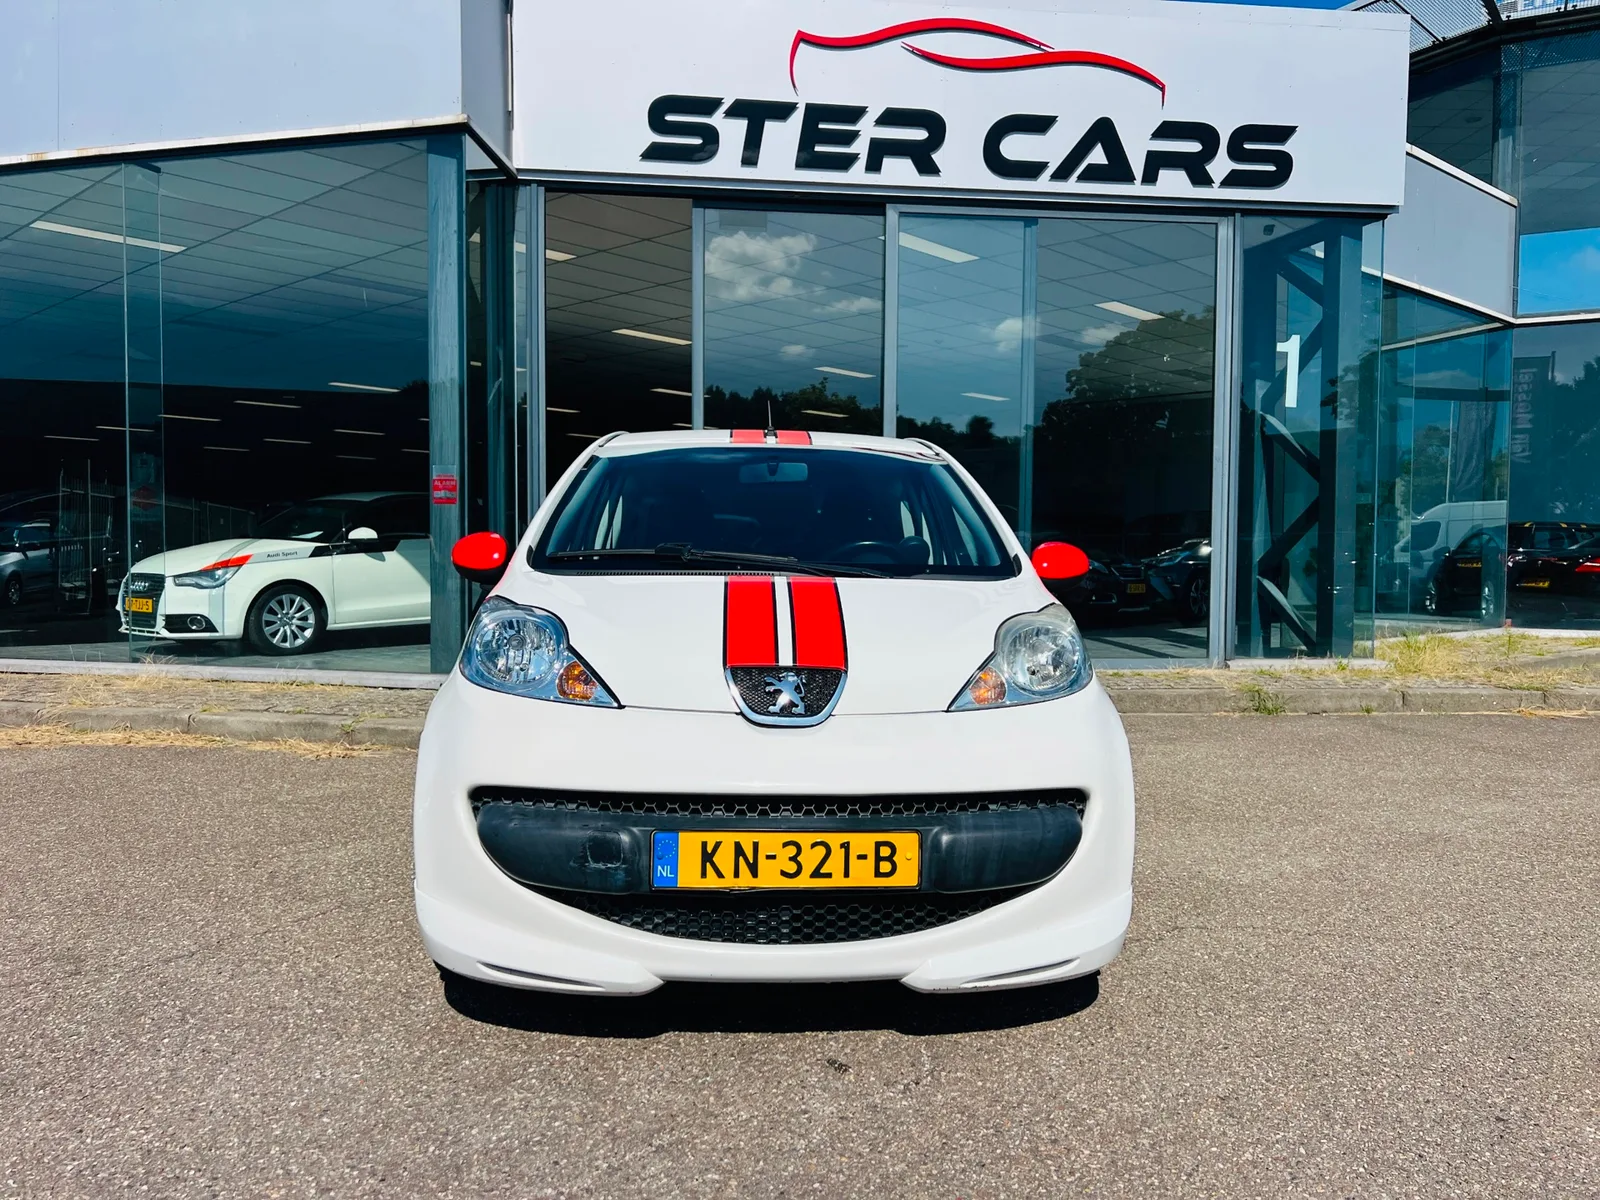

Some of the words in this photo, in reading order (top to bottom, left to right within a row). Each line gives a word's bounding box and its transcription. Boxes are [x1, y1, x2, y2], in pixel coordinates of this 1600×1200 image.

[639, 94, 947, 176] STER
[982, 113, 1299, 190] CARS
[1276, 334, 1301, 408] 1
[657, 865, 675, 878] NL
[700, 840, 898, 879] KN-321-B
